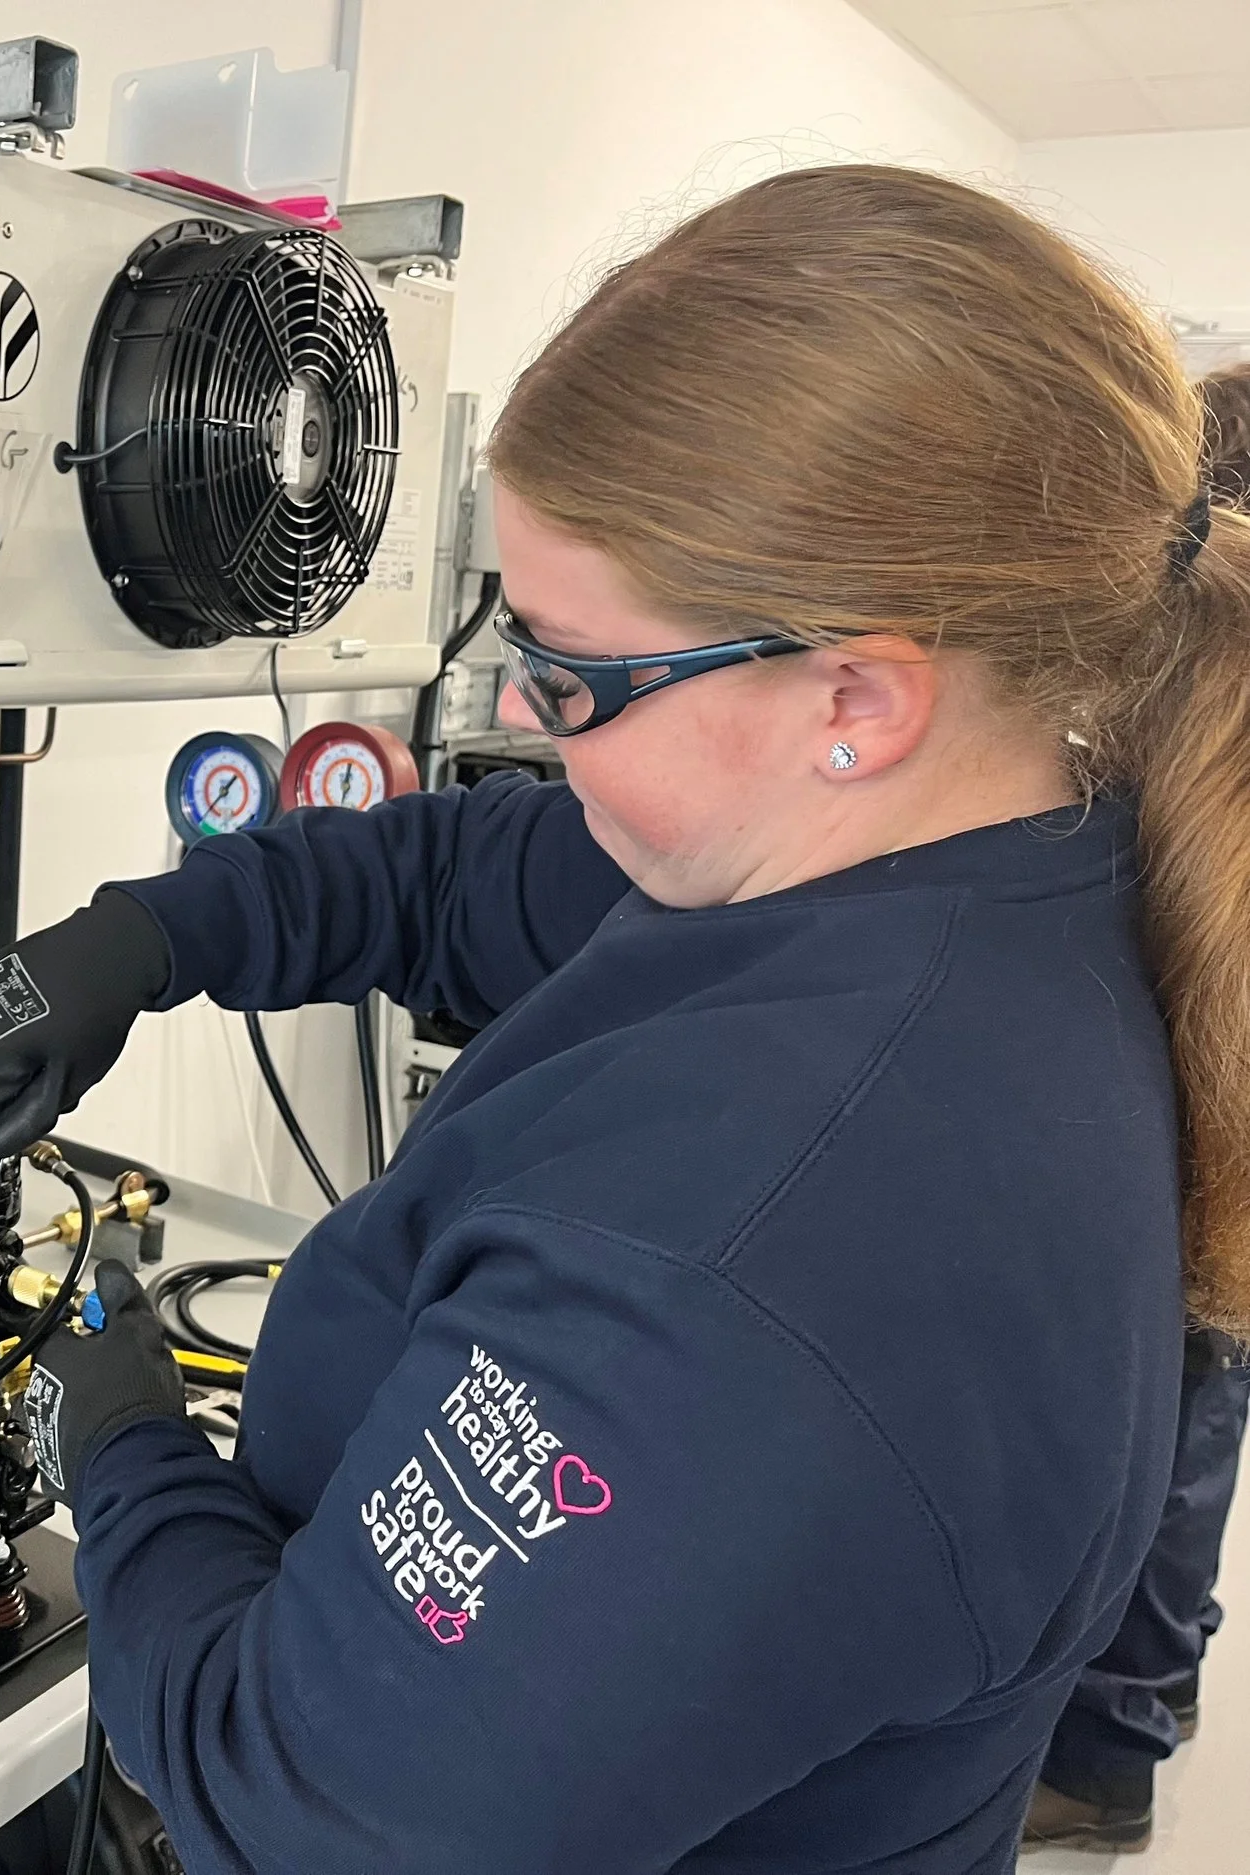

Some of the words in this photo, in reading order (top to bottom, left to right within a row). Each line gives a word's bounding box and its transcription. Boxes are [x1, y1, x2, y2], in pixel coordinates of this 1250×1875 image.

[440, 1375, 567, 1540] healthy
[469, 1377, 486, 1404] to
[480, 1400, 511, 1440] stay
[470, 1344, 563, 1465] working
[361, 1489, 426, 1603] safe
[390, 1456, 500, 1582] proud
[395, 1492, 416, 1531] to
[417, 1542, 486, 1621] work
